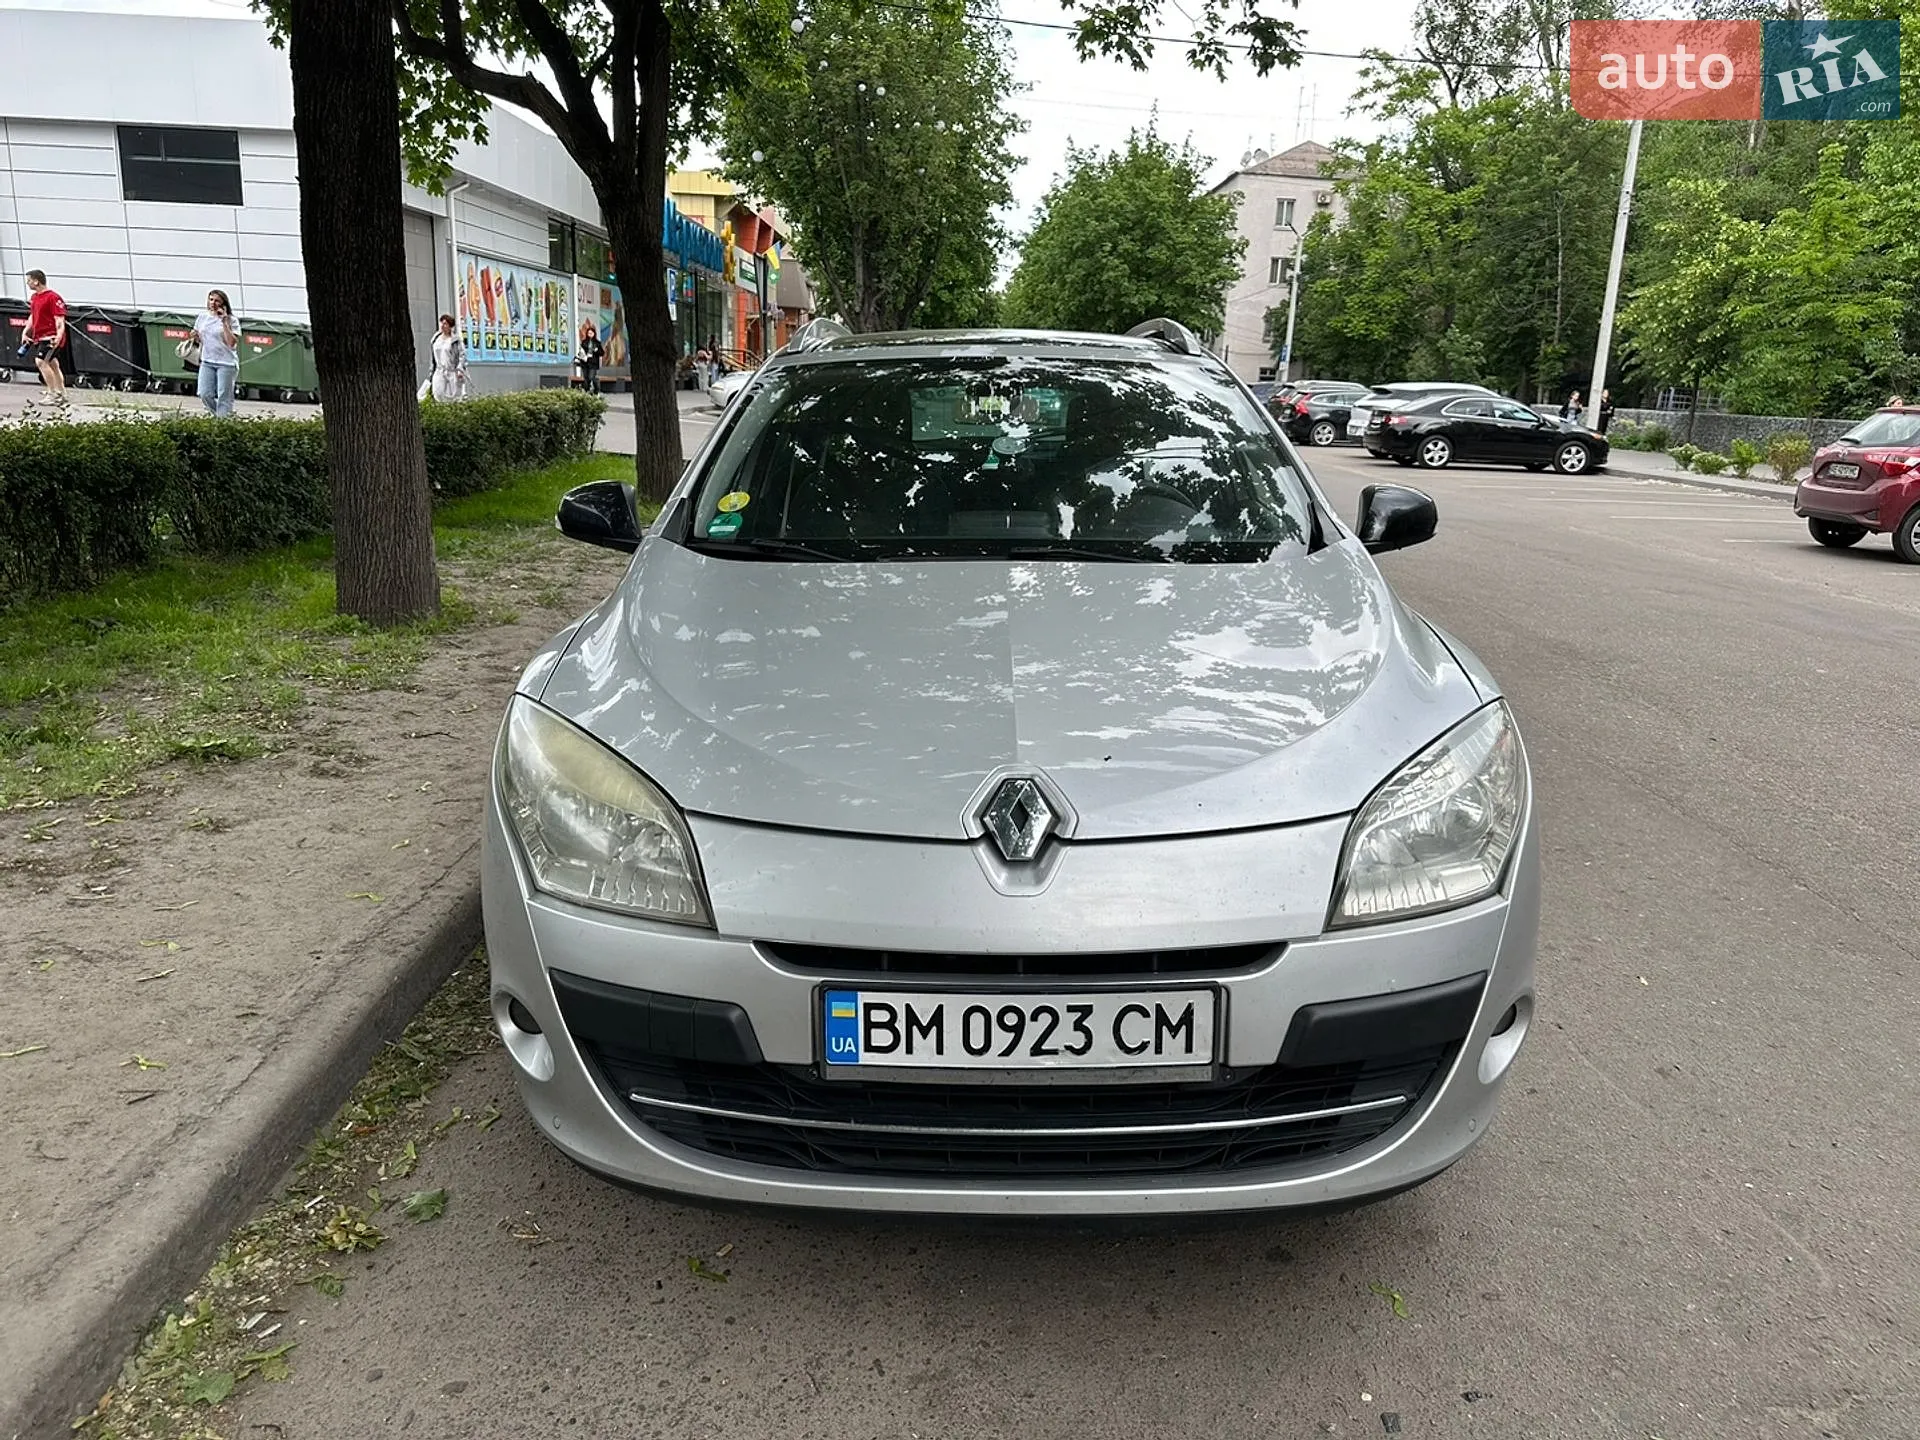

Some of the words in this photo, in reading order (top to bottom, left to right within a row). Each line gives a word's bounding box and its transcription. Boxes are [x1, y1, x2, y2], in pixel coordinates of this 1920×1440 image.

[831, 1037, 856, 1053] UA
[863, 1002, 944, 1056] BM
[961, 1004, 1094, 1057] 0923
[1112, 1002, 1194, 1056] CM
